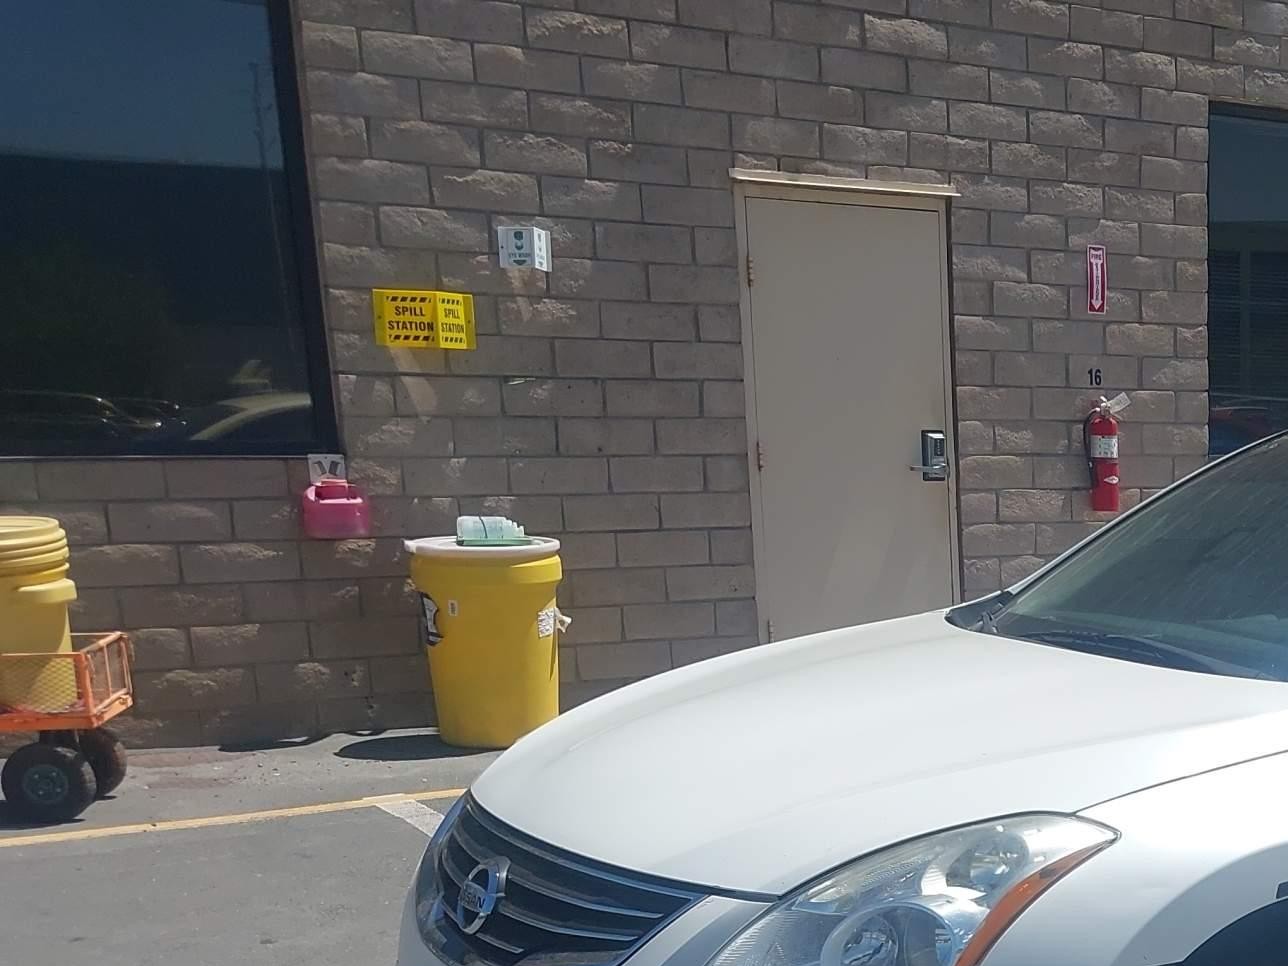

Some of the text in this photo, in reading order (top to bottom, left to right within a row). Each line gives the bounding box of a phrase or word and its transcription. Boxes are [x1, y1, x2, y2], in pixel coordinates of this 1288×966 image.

[394, 305, 426, 317] SPILL
[443, 307, 460, 319] SPILL
[388, 320, 434, 332] STATION
[441, 322, 465, 334] STATION
[1088, 368, 1102, 386] 16
